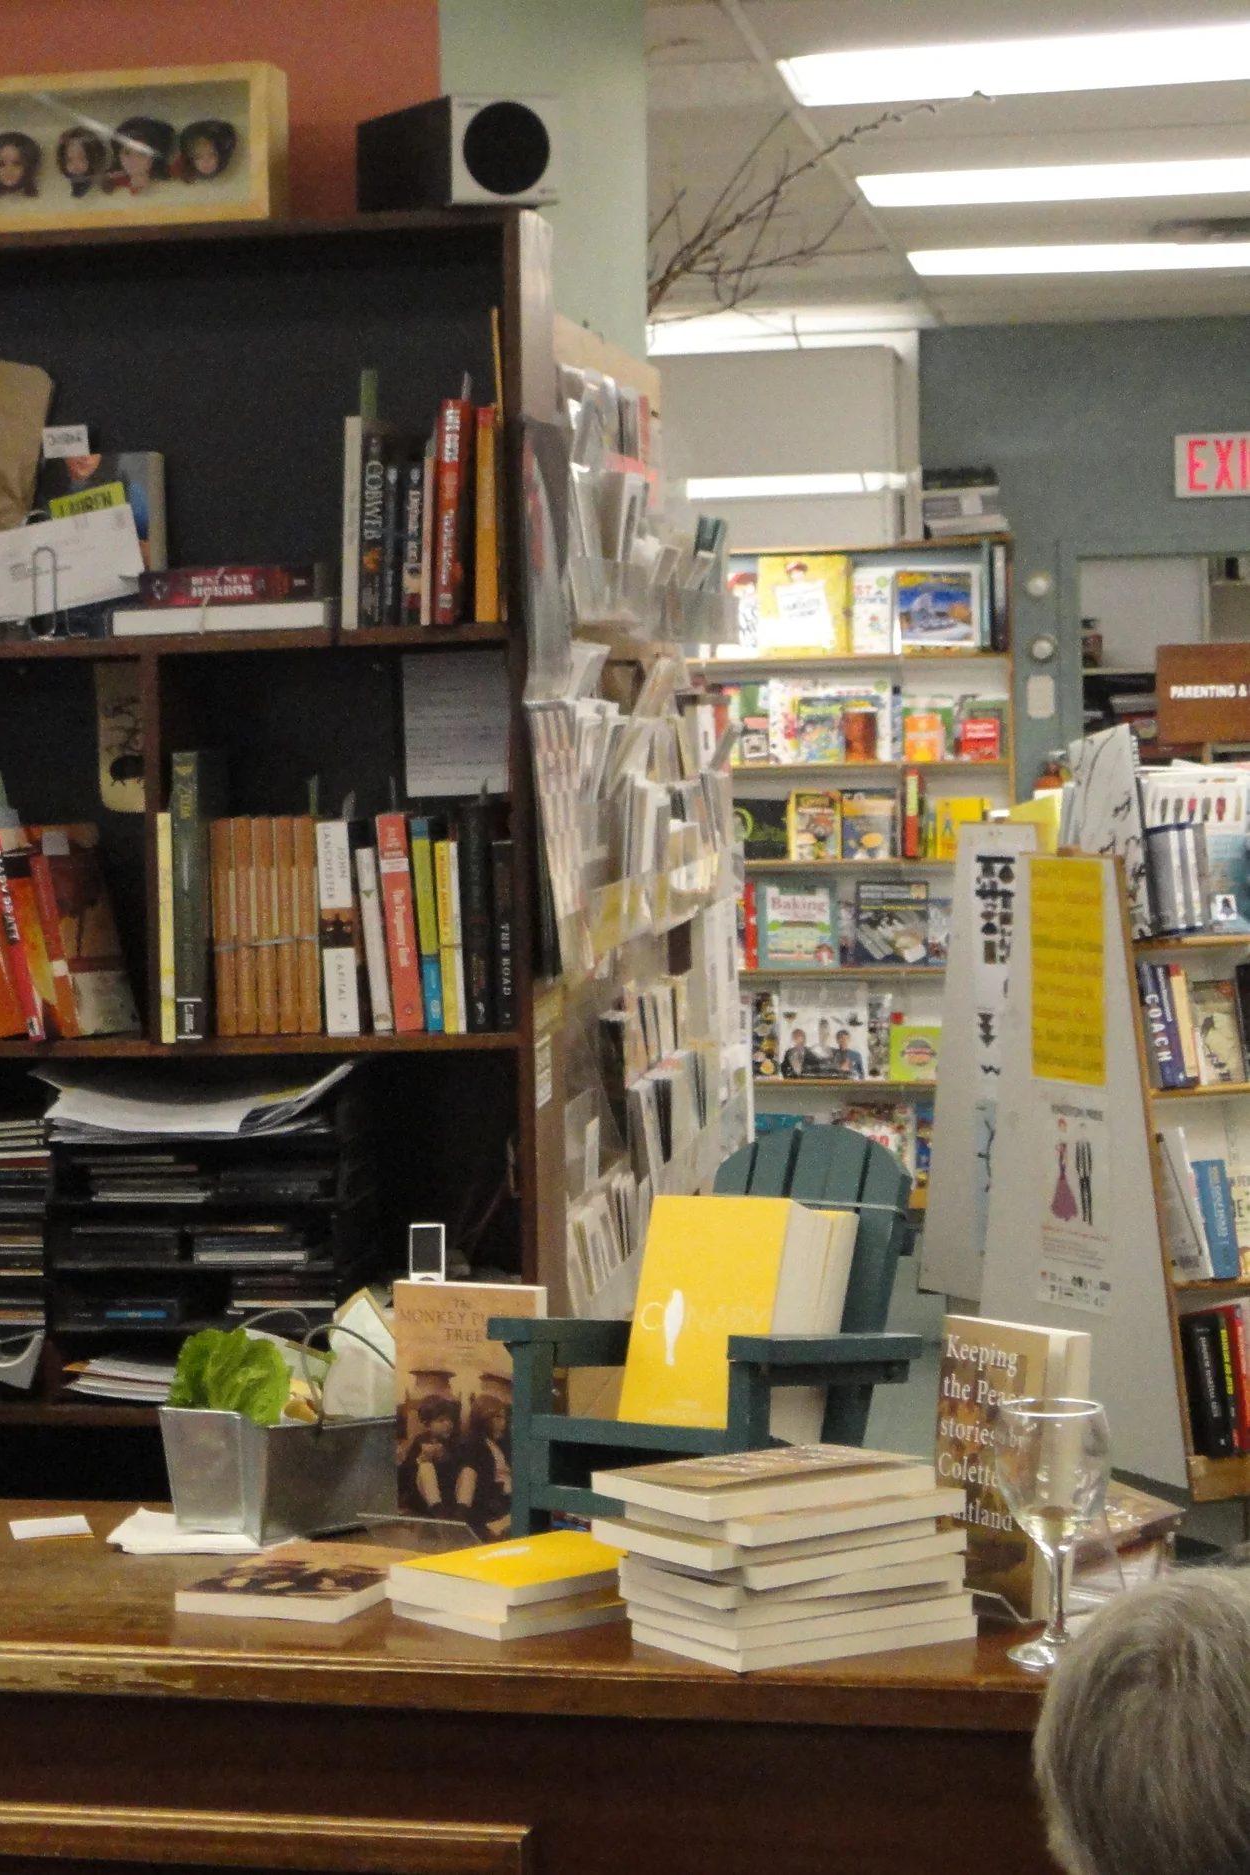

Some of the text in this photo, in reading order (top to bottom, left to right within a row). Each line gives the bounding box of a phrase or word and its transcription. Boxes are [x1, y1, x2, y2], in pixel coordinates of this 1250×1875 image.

[1187, 438, 1250, 491] EXI
[364, 460, 384, 541] COBWEB
[191, 585, 254, 598] HORROR
[223, 573, 253, 585] NEW
[1170, 683, 1248, 700] PARENTING &
[321, 825, 335, 900] LANCHESTER
[338, 846, 348, 880] JOHN
[2, 895, 21, 942] PRATT
[770, 897, 827, 914] Baking
[500, 923, 512, 996] THE ROAD
[335, 954, 347, 1001] CAPITAL
[1145, 993, 1173, 1062] COACH
[400, 1308, 467, 1325] MONKEY
[641, 1302, 767, 1332] CNARY
[443, 1327, 481, 1343] TREE
[946, 1333, 1019, 1378] Keeping
[943, 1373, 971, 1401] the
[938, 1452, 1001, 1489] Colette
